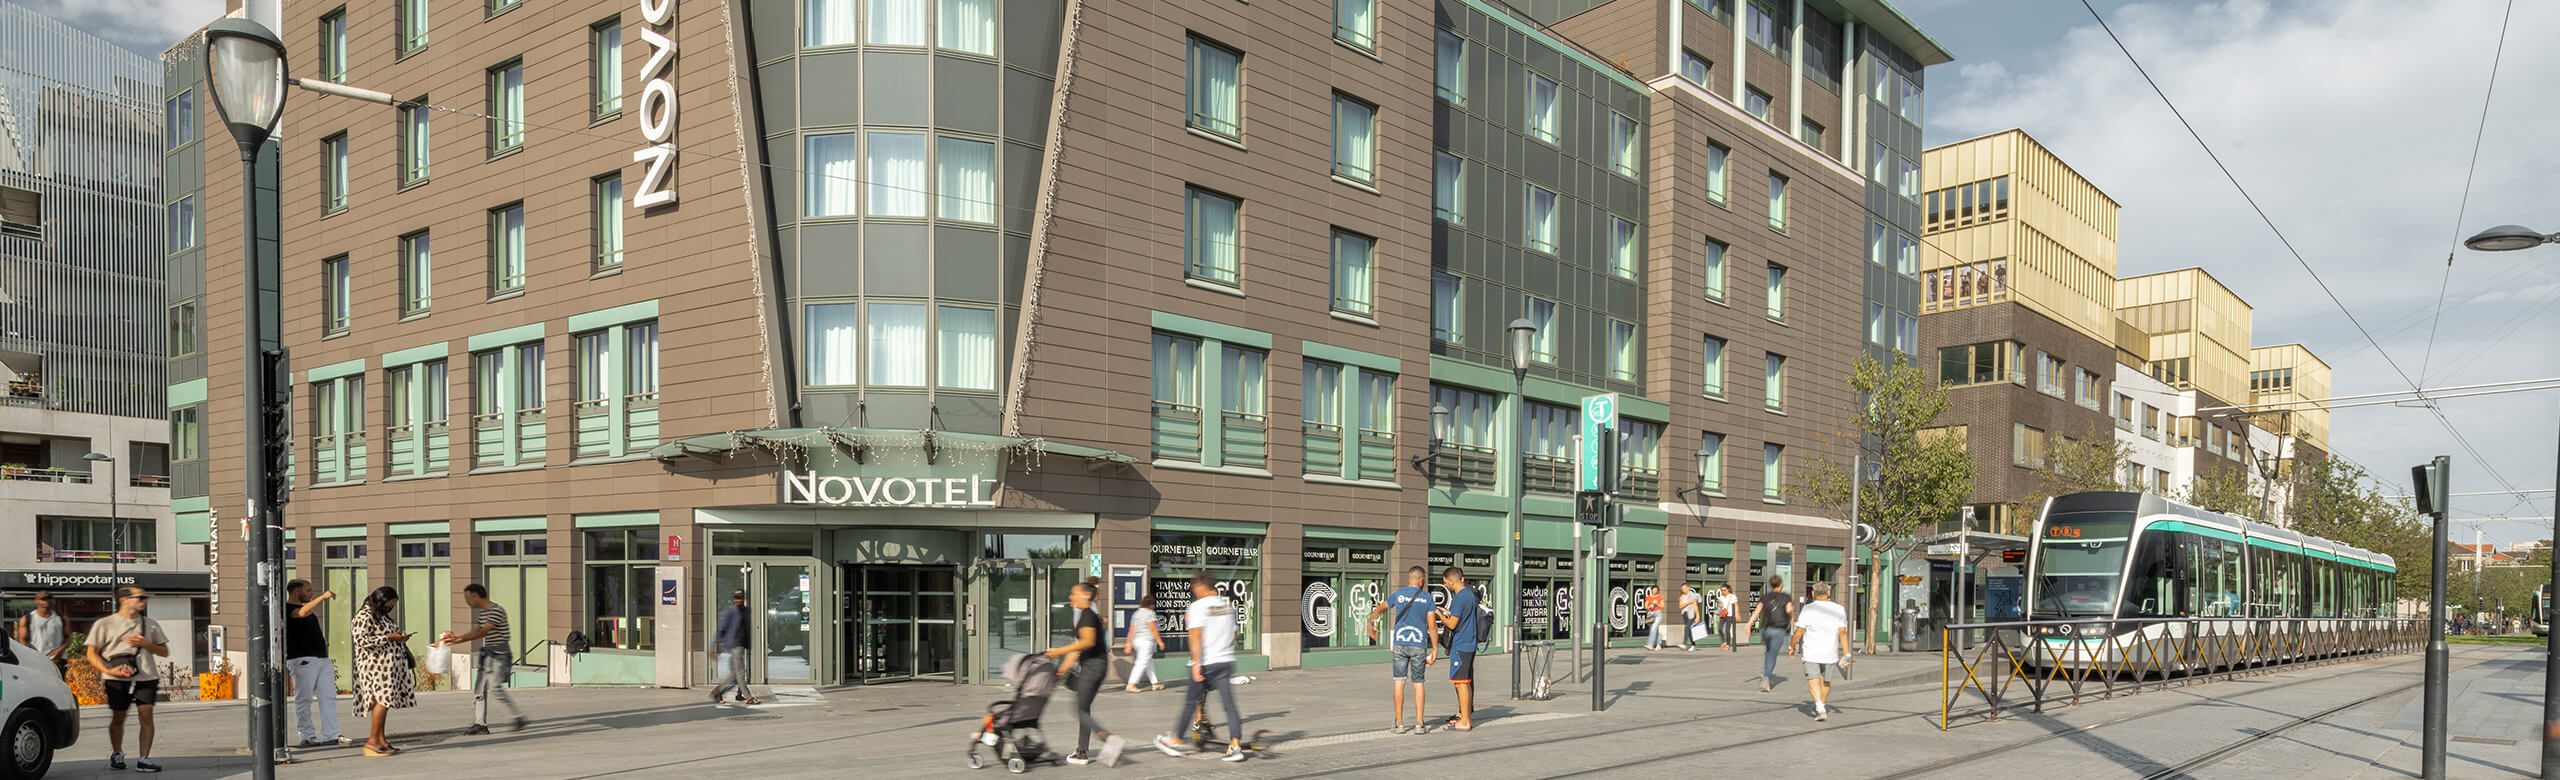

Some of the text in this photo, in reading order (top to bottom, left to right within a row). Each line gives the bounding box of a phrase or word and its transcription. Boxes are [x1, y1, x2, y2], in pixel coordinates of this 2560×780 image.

[784, 470, 997, 505] NOVOTEL
[1580, 512, 1598, 520] STOP
[210, 507, 219, 614] RESTAURANT
[1159, 582, 1183, 591] TAPAS
[1522, 586, 1548, 597] SAVOUR
[1156, 591, 1191, 599] COCKTAILS
[1156, 600, 1172, 608] NON
[1302, 582, 1337, 637] G
